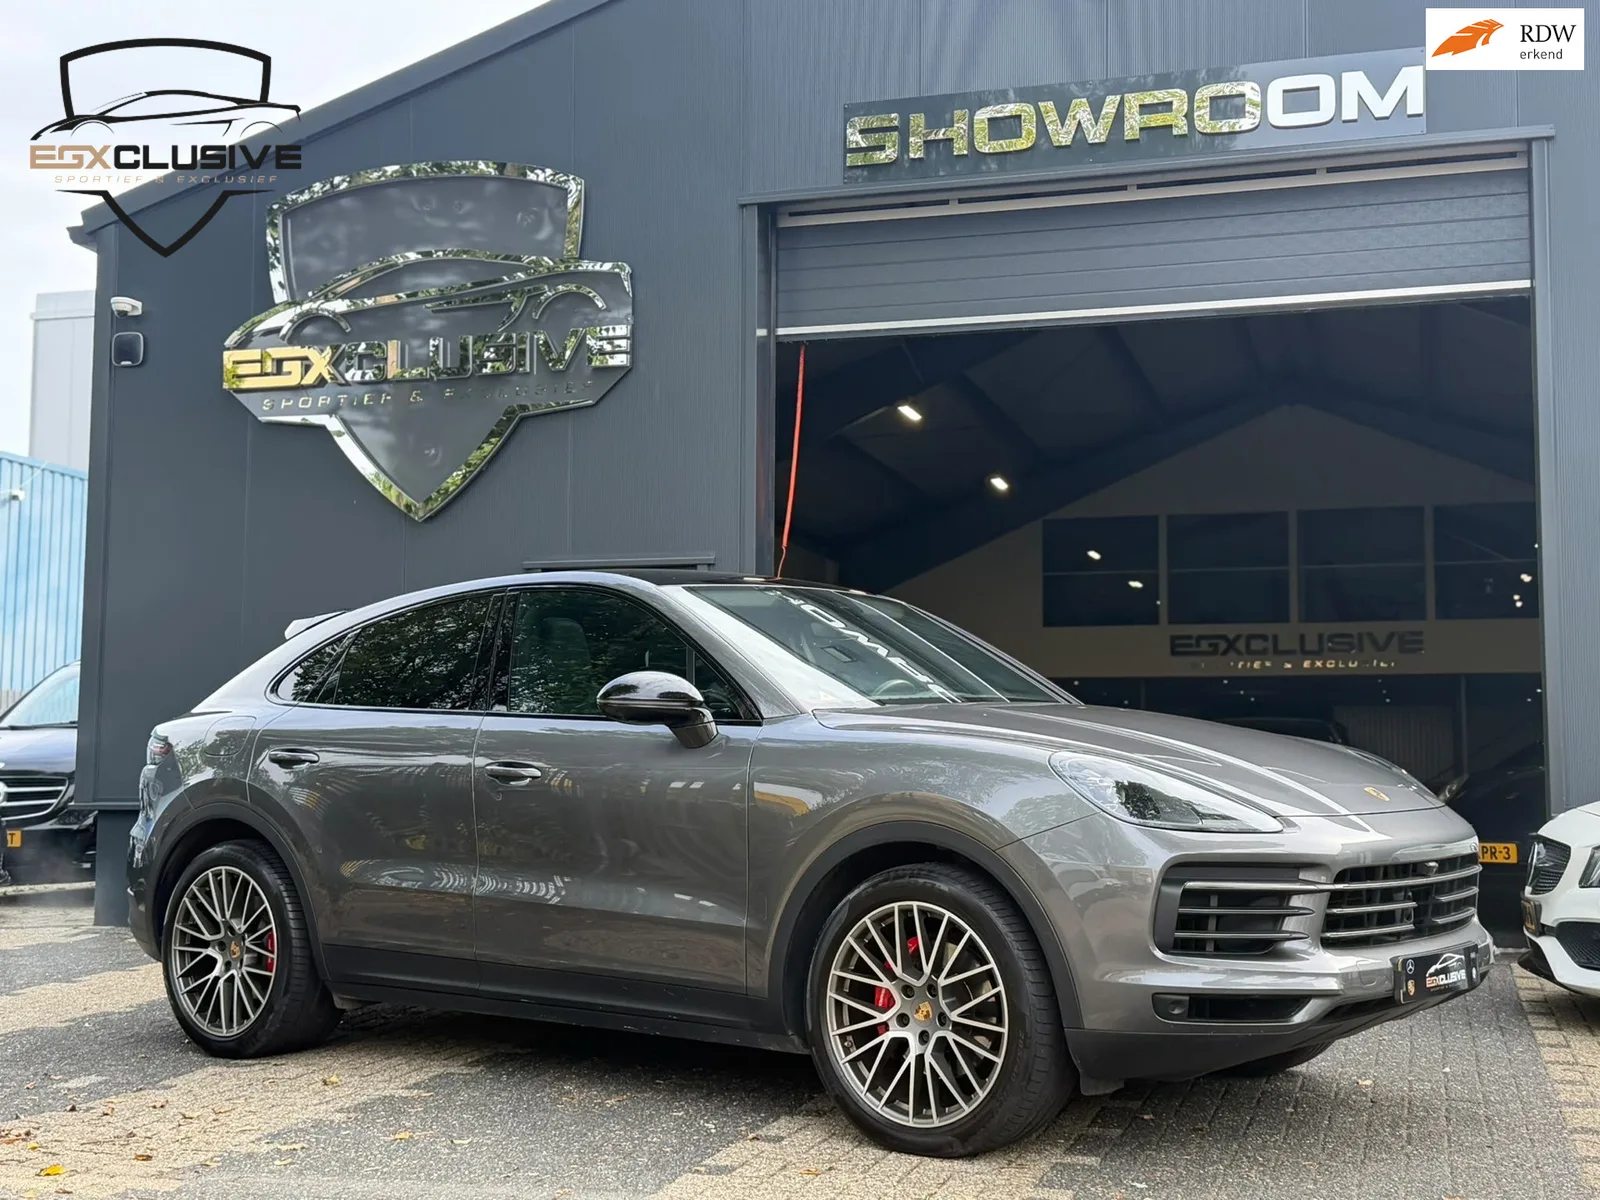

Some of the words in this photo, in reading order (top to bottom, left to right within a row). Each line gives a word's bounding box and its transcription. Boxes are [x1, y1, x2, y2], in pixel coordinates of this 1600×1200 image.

[845, 64, 1425, 166] SHOWROOM
[222, 324, 632, 389] EGXCLUSIVE
[1169, 630, 1425, 657] EGXCLUSIVE
[1479, 846, 1511, 861] PR-3
